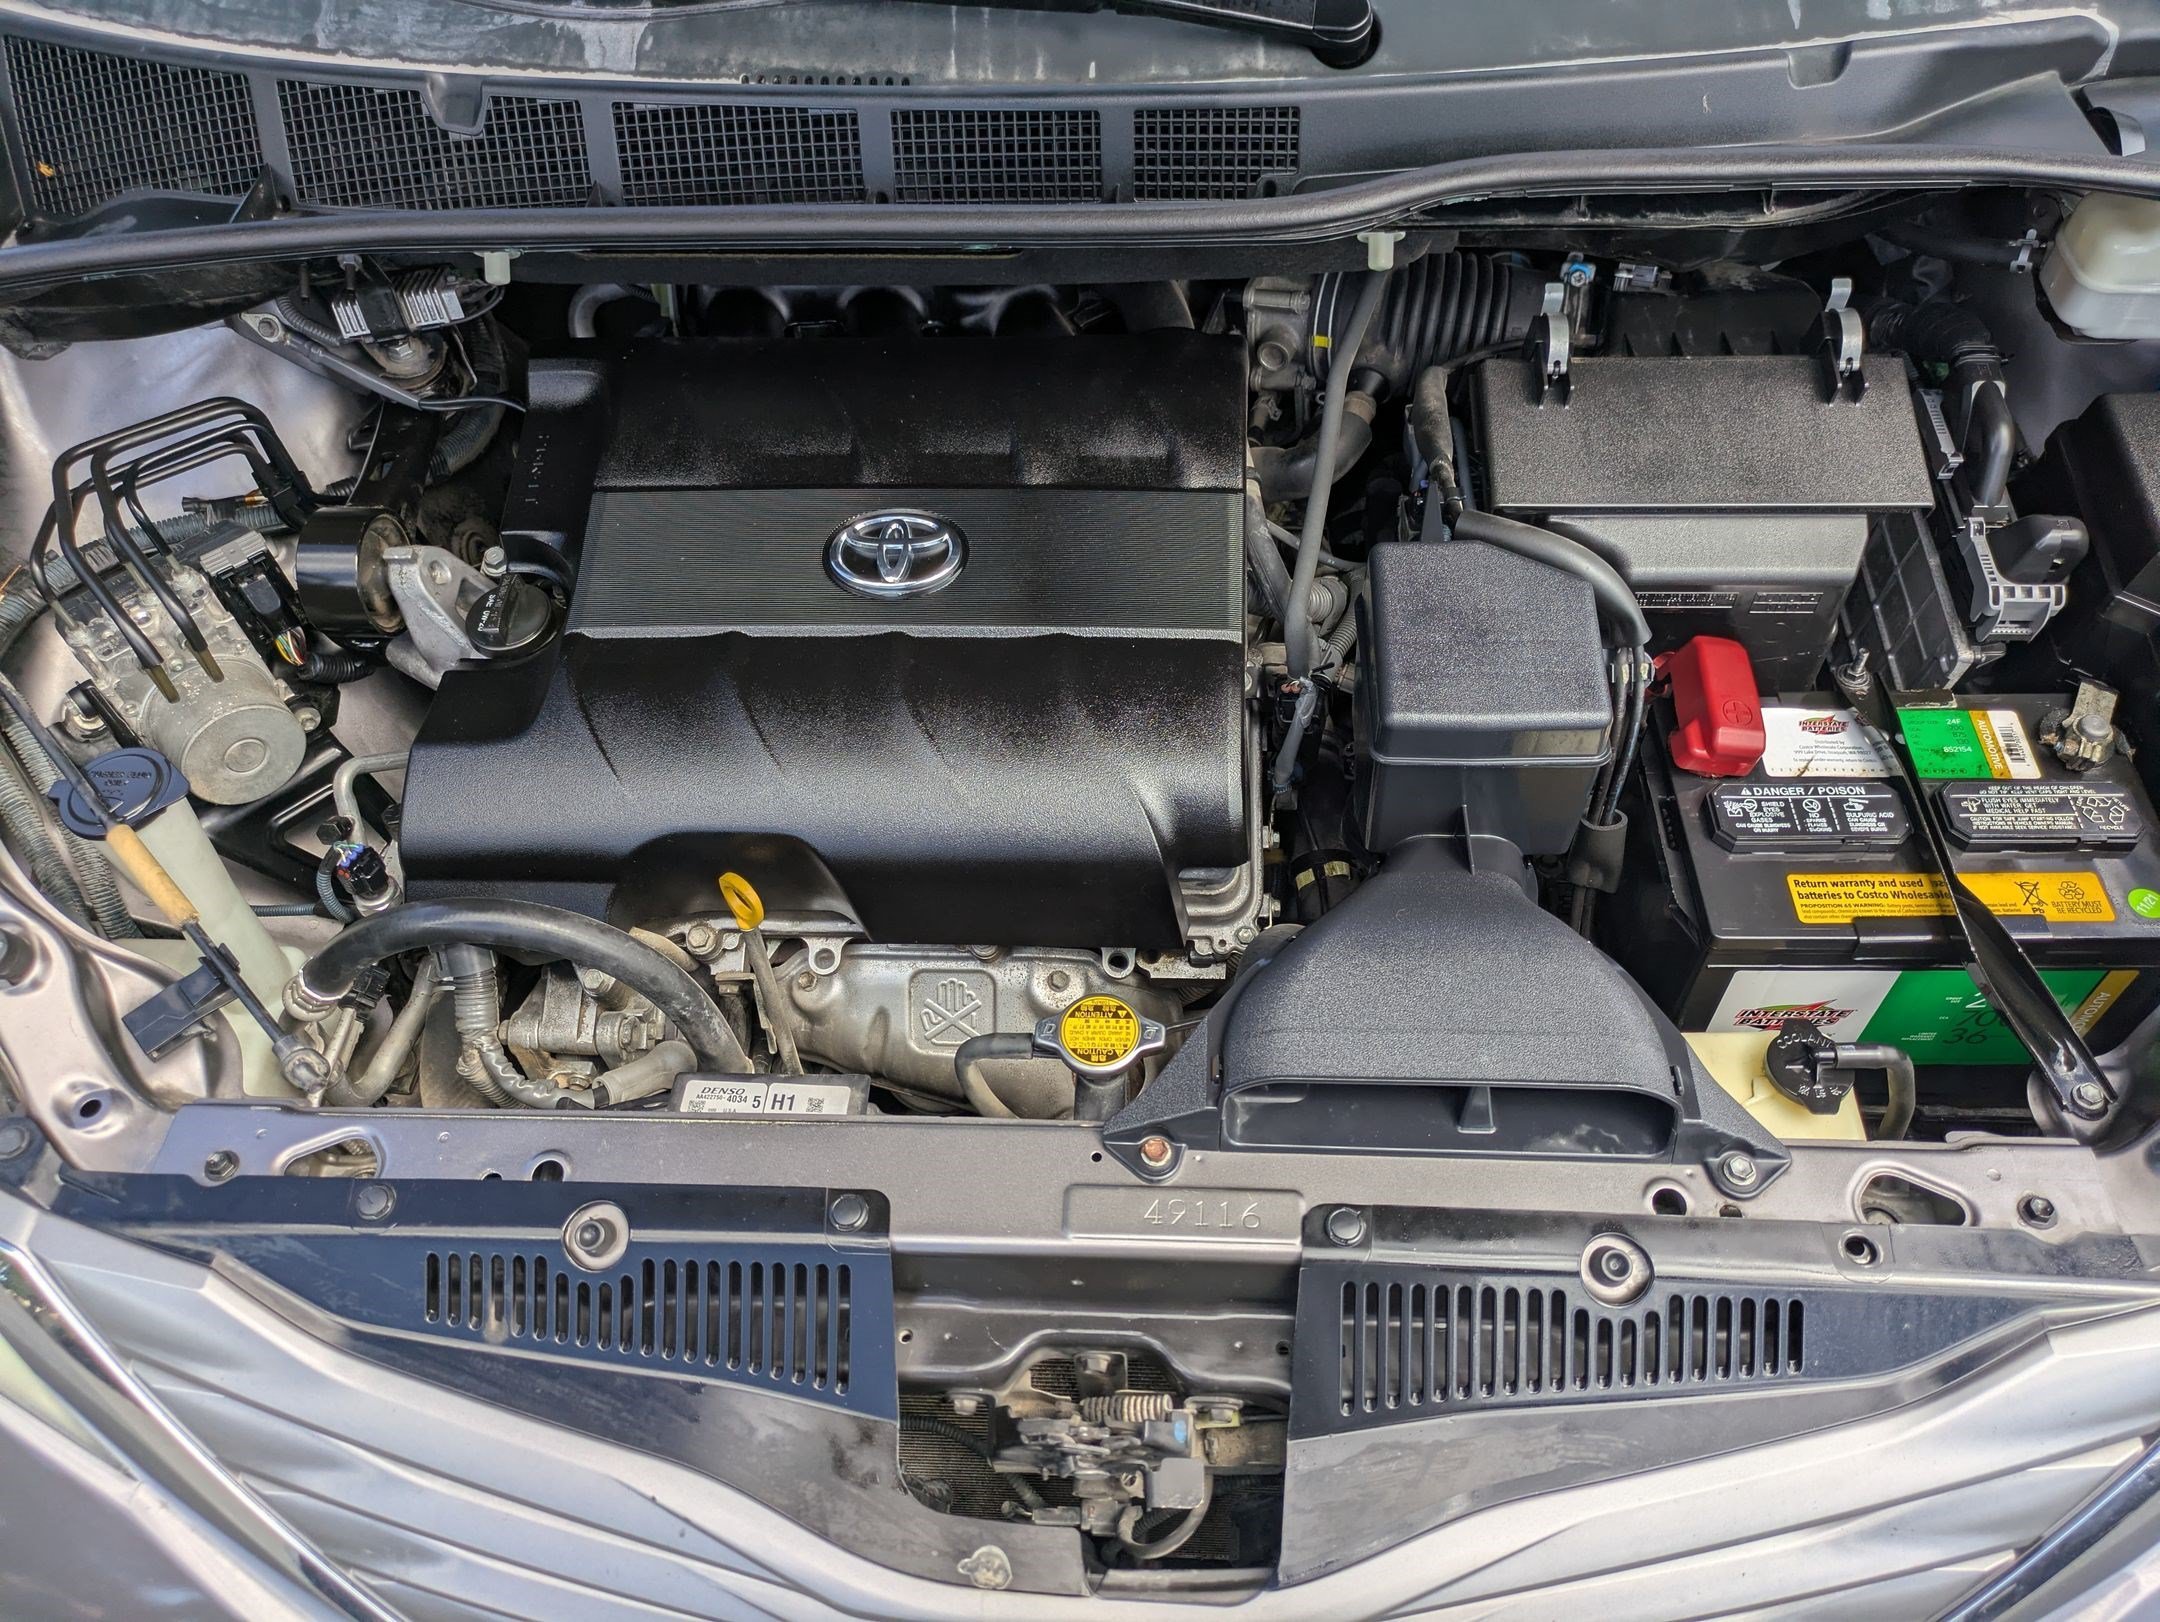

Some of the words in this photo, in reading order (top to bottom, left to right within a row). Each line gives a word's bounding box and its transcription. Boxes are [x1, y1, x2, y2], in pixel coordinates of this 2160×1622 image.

[1977, 719, 2003, 770] AUTOMOTIVE
[1753, 787, 1805, 796] DANGER
[1807, 787, 1814, 796] /
[1817, 786, 1866, 795] POISON
[1794, 879, 1828, 888] Return
[1830, 880, 1875, 889] warranty
[1878, 879, 1898, 888] and
[1901, 879, 1924, 888] used
[1797, 890, 1842, 900] batteries
[1844, 891, 1855, 900] to
[1856, 890, 1889, 900] Costco
[2051, 900, 2081, 908] BATTERY
[2081, 900, 2103, 908] MUST
[2136, 893, 2160, 914] 11/21
[1737, 1009, 1854, 1018] INTERSTATE
[1776, 1033, 1832, 1049] COOLANT
[701, 1087, 746, 1095] DENSO
[752, 1095, 762, 1109] 5
[770, 1093, 796, 1111] H1
[1143, 1199, 1261, 1228] 49116
